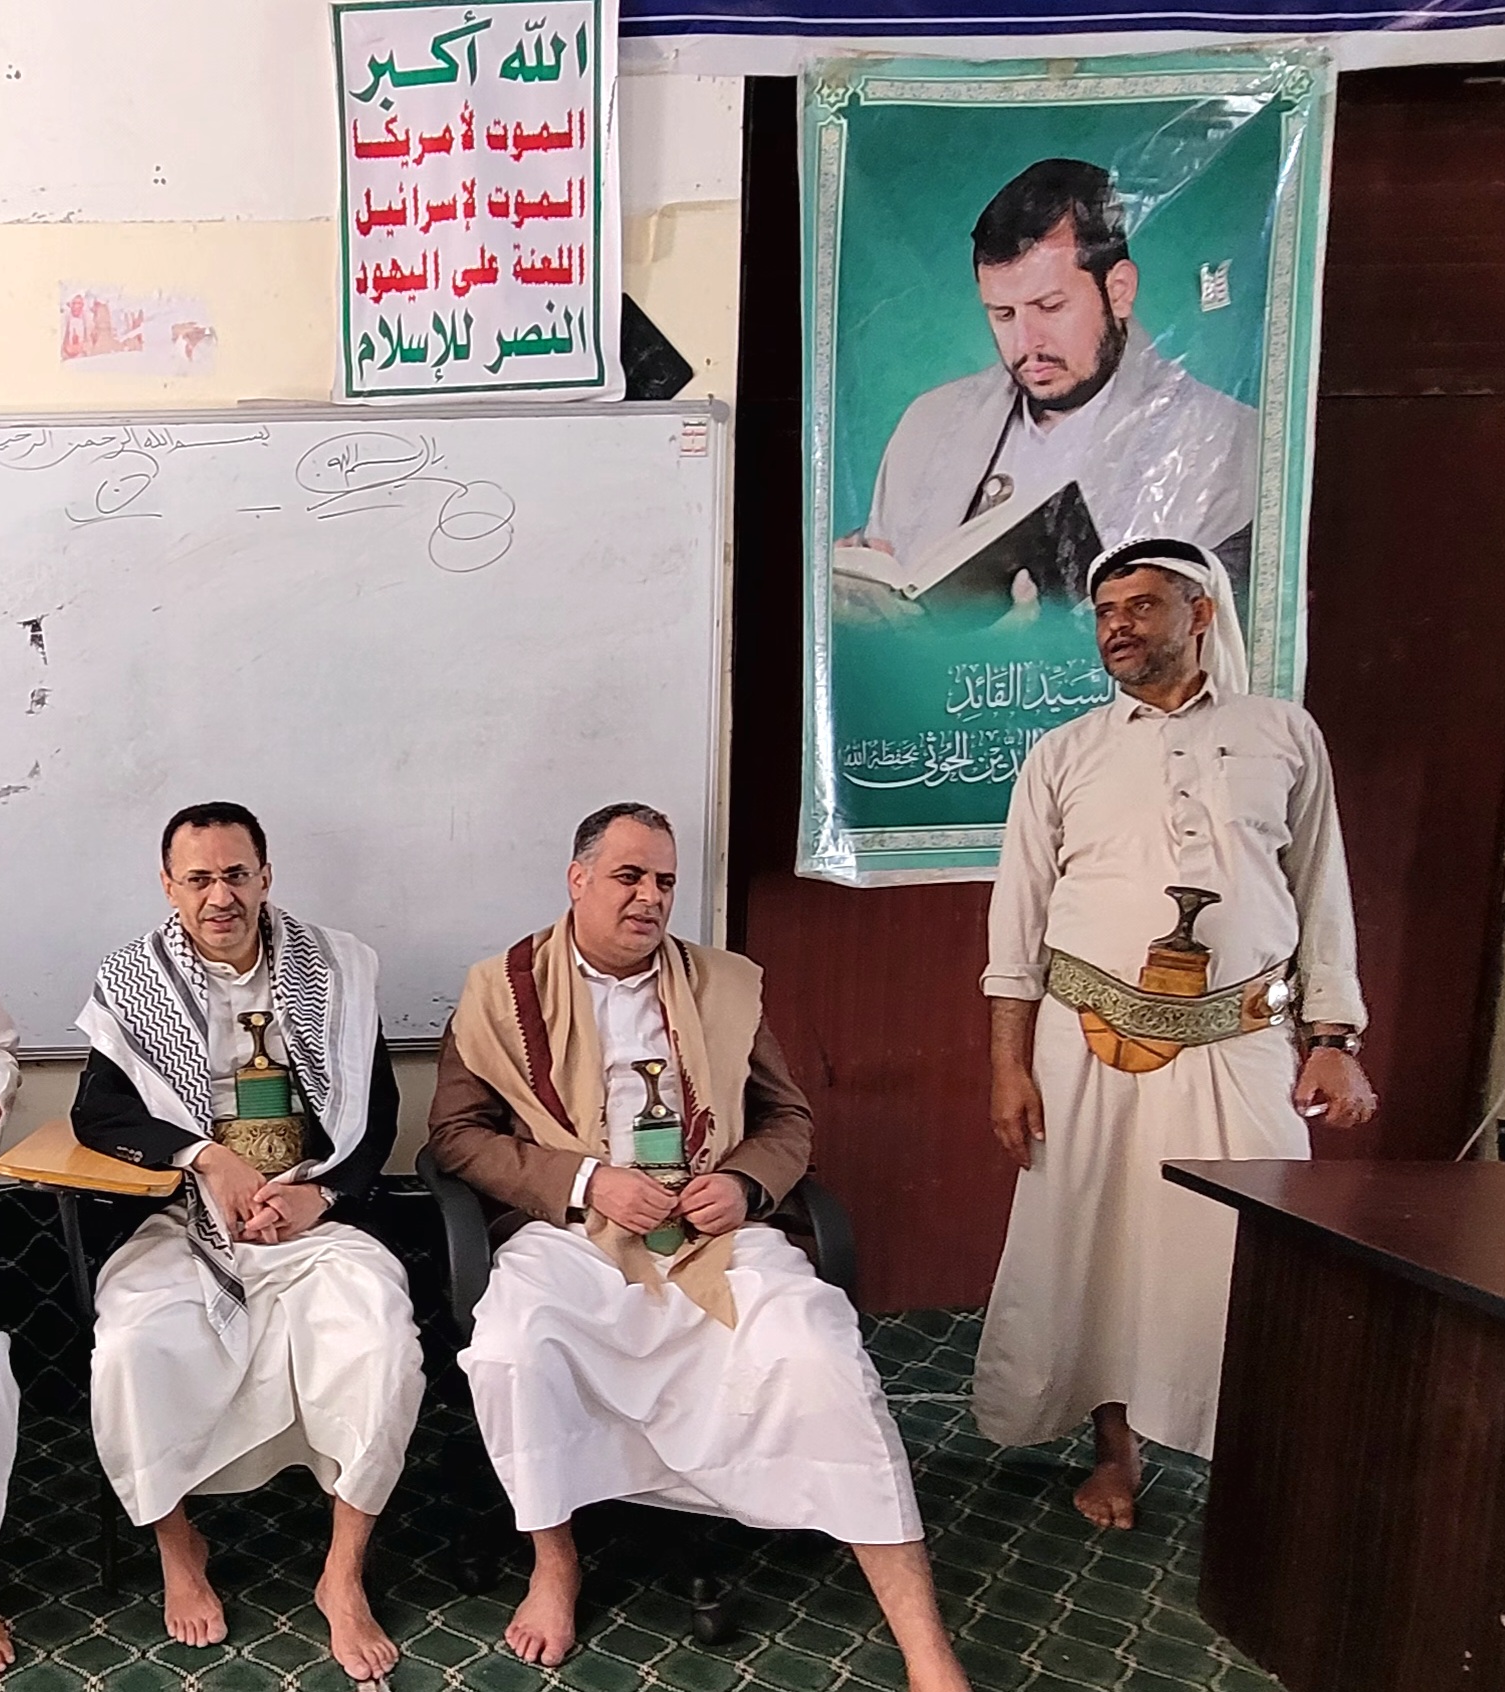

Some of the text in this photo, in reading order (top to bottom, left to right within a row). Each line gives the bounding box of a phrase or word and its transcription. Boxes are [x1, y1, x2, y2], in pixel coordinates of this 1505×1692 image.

[348, 9, 493, 112] أكبر
[351, 100, 586, 168] الموت لأمريكا
[354, 174, 586, 238] الموت لإسرائيل
[355, 242, 586, 304] اللعنة على اليهود
[356, 299, 588, 384] النصر للإسلام
[143, 427, 176, 450] الله
